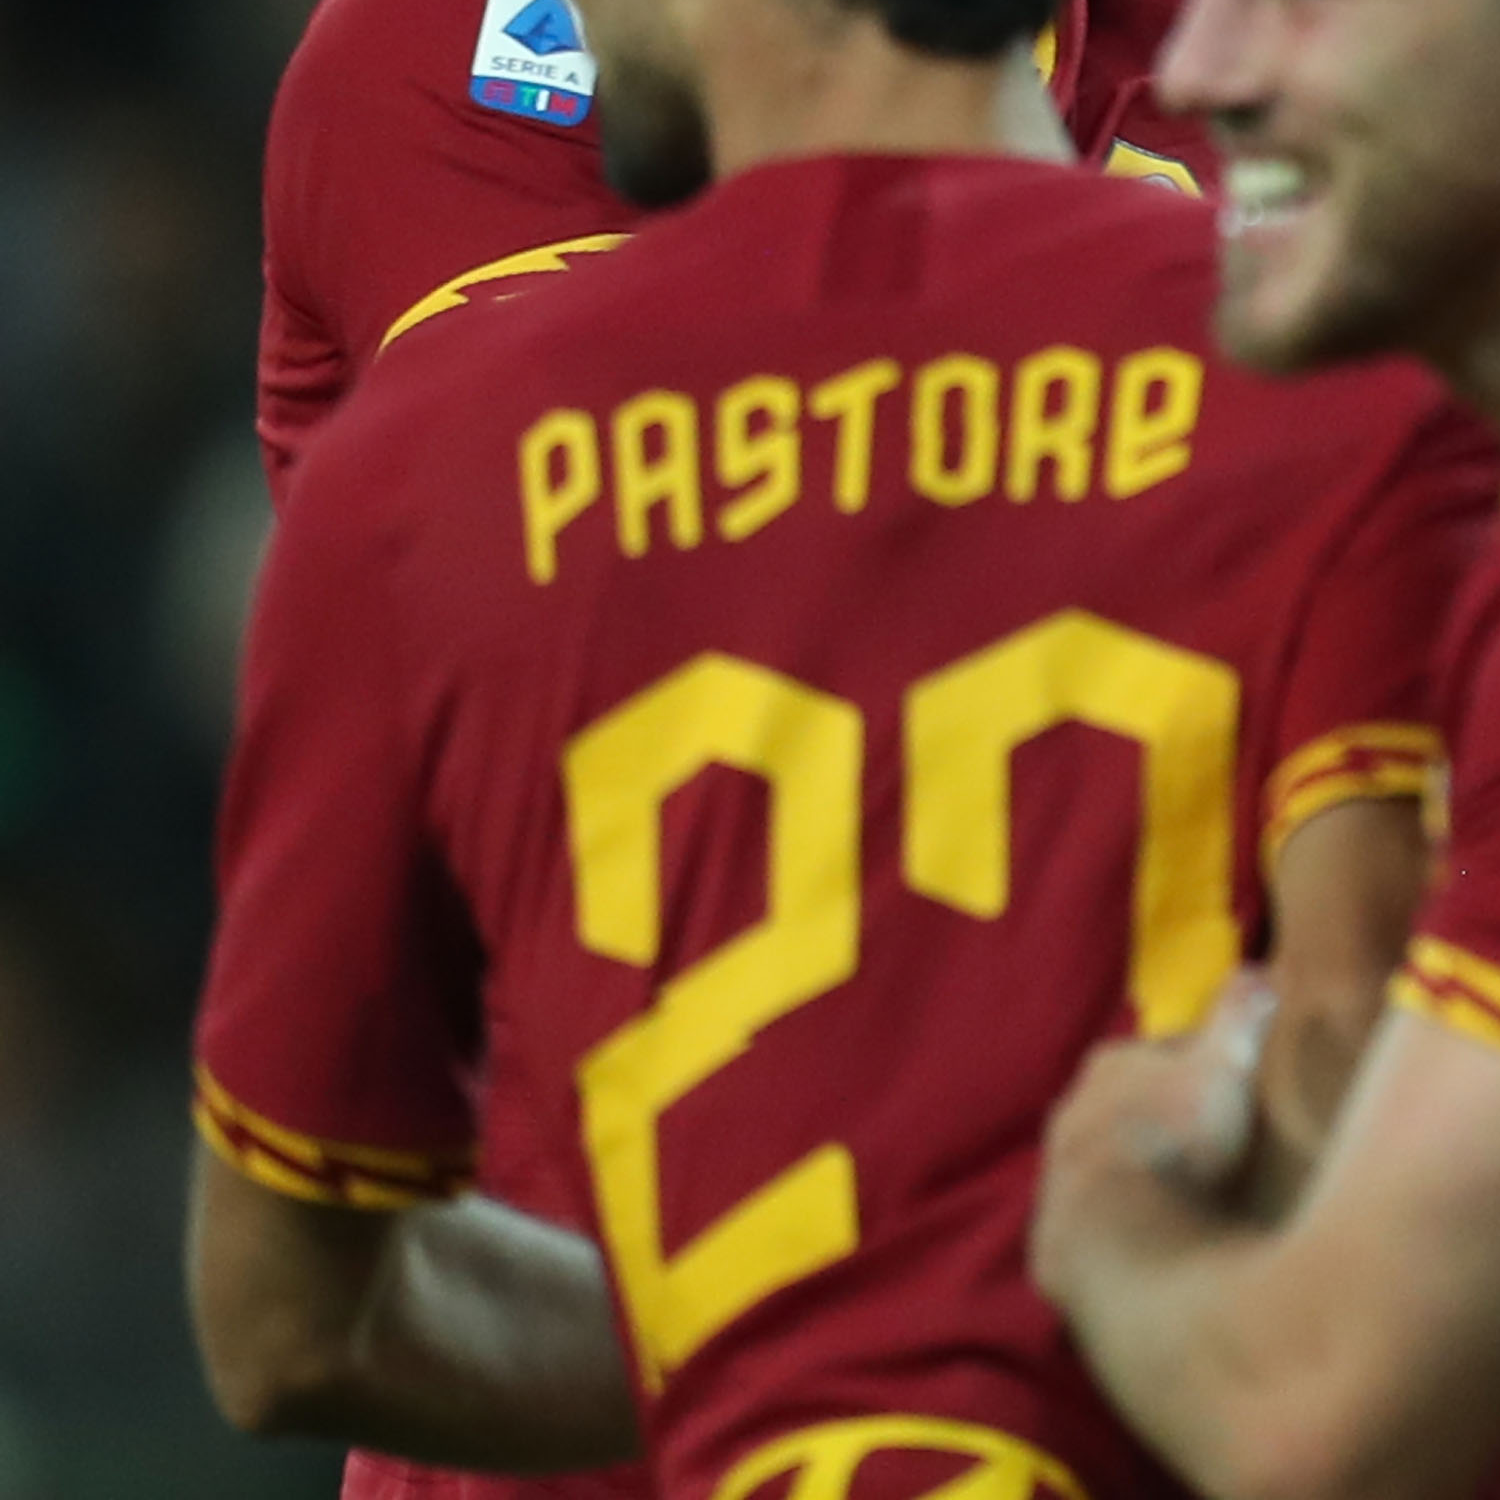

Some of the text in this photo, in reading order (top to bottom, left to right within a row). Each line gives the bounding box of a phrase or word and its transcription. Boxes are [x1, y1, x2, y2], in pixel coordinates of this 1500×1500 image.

[490, 56, 581, 86] SERIE A
[519, 344, 1204, 586] PASTORE
